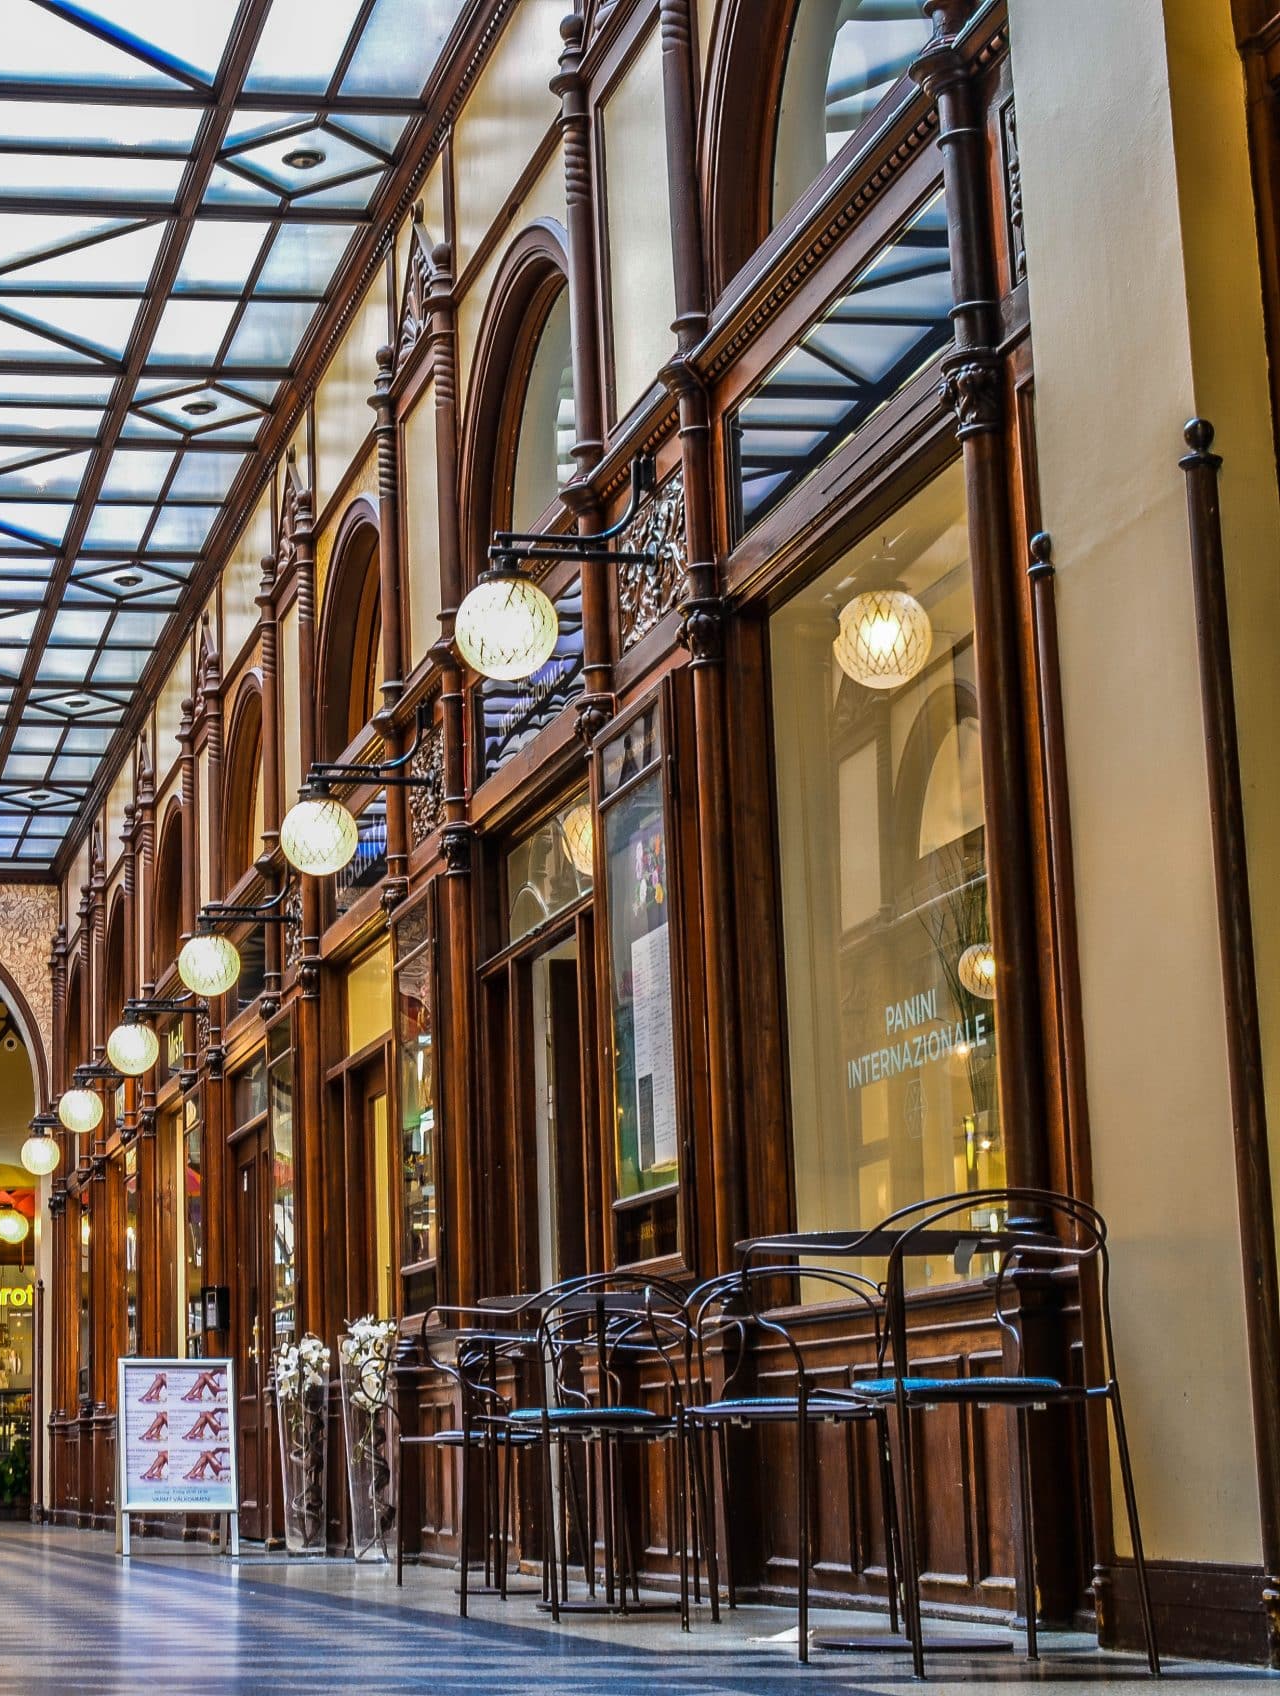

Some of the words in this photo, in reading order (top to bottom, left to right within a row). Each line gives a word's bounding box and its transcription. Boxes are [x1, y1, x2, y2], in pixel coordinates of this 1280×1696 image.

[499, 659, 565, 737] INTERNAZIONALE
[885, 988, 937, 1036] PANINI
[847, 1014, 987, 1089] INTERNAZIONALE
